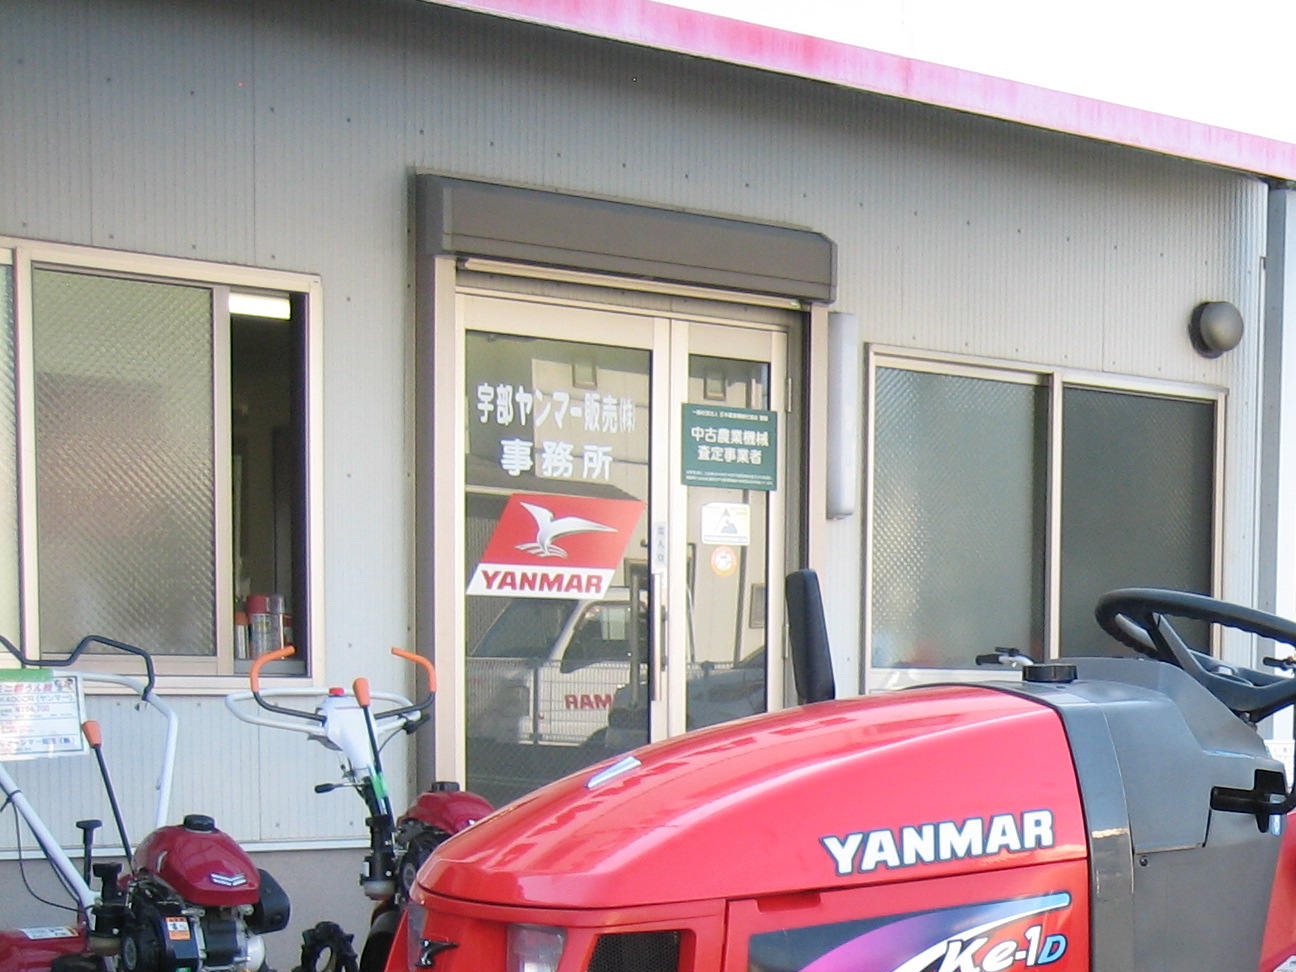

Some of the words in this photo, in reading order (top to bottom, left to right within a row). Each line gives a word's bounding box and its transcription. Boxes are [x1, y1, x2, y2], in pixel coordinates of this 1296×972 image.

[500, 438, 613, 481] 事務所
[481, 570, 603, 593] YANMAR
[821, 809, 1054, 876] YANMAR
